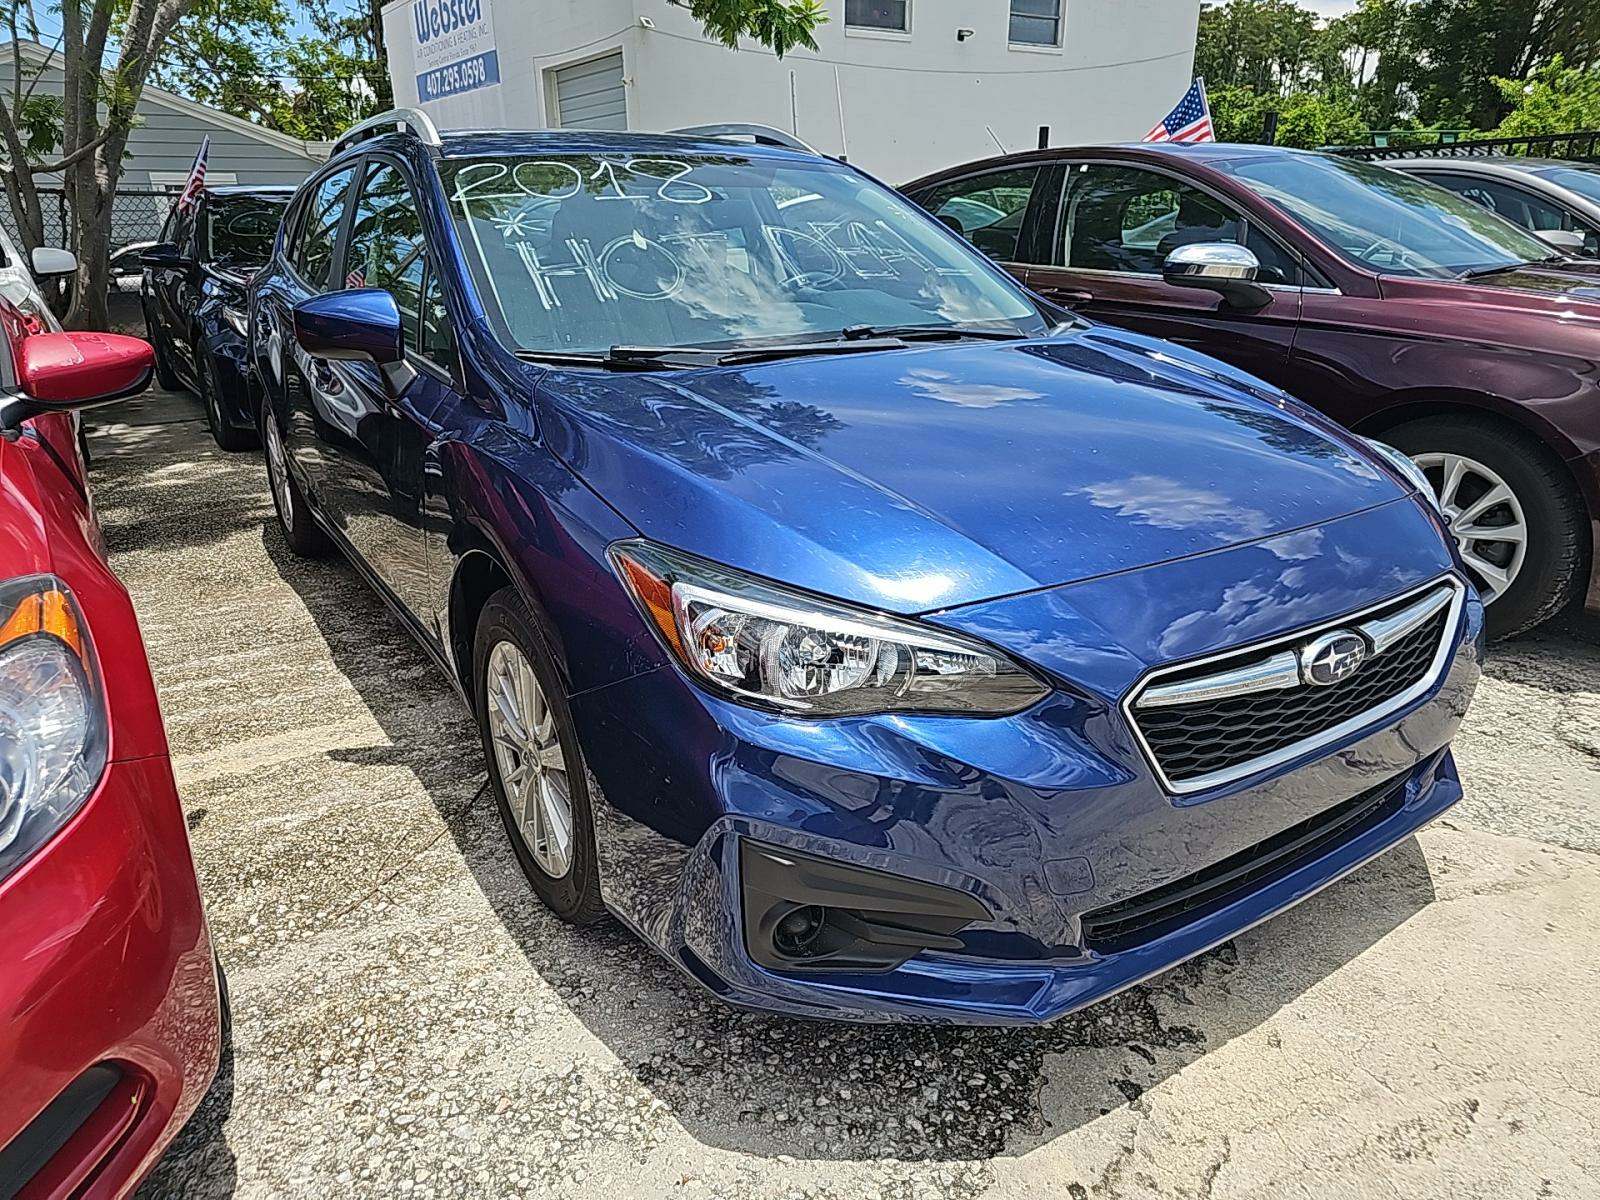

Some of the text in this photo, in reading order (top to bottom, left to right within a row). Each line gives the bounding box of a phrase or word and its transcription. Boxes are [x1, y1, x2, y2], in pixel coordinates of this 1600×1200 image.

[413, 0, 481, 44] Webster
[426, 57, 486, 96] 407.295.0598
[450, 158, 713, 204] 2018
[514, 229, 728, 310] HOT
